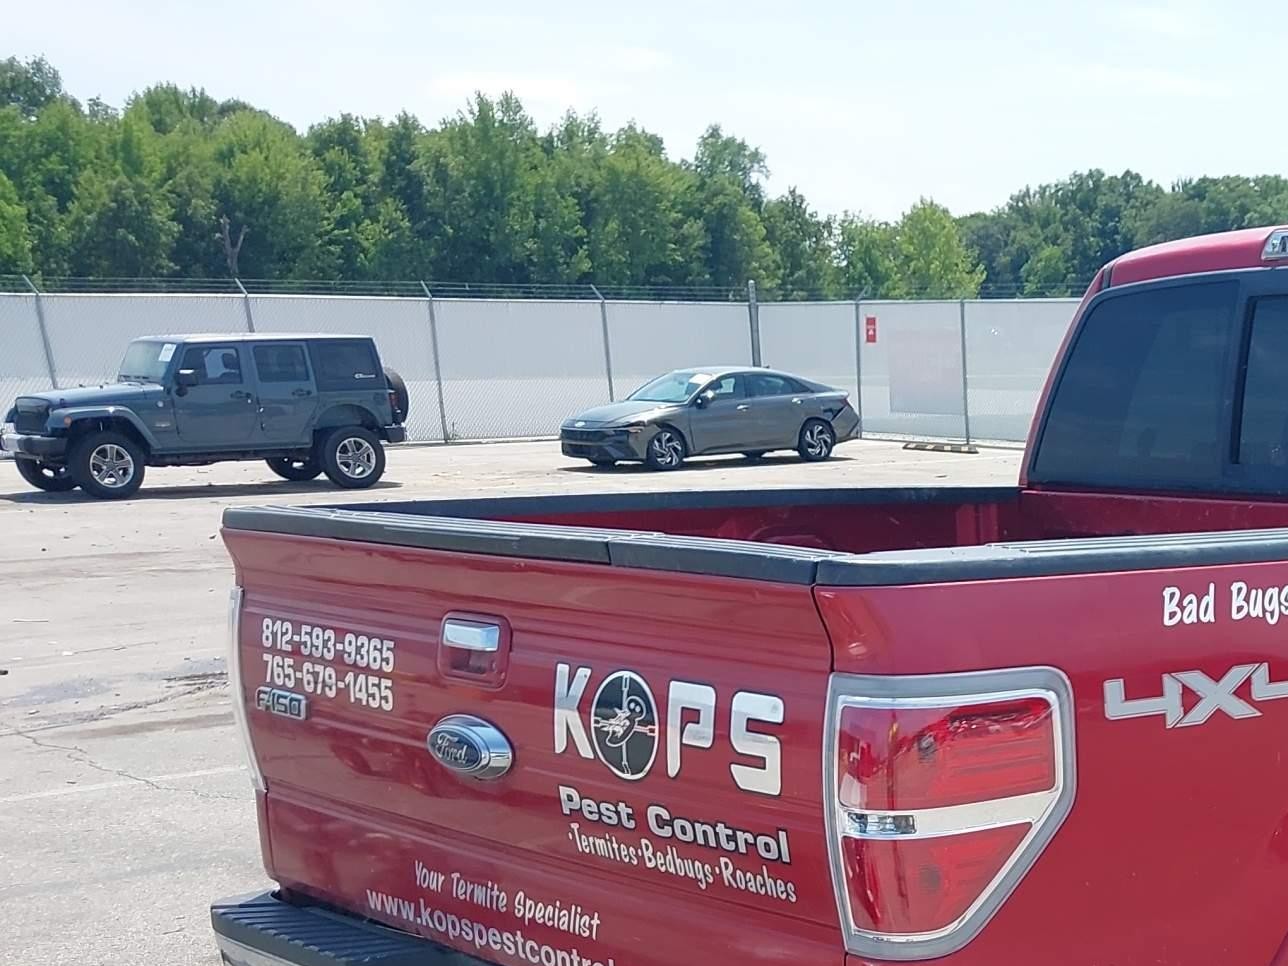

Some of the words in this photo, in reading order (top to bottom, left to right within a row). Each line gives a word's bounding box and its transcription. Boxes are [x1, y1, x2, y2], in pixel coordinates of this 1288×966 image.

[1163, 583, 1215, 626] Bad
[262, 618, 395, 672] 812-593-9365
[263, 653, 394, 711] 765-679-1455
[435, 732, 468, 765] Ford
[553, 662, 785, 796] KOPS
[558, 785, 636, 830] Pest
[647, 805, 791, 864] Control
[415, 860, 445, 893] Your
[451, 872, 507, 912] Termite
[514, 891, 601, 941] Specialist
